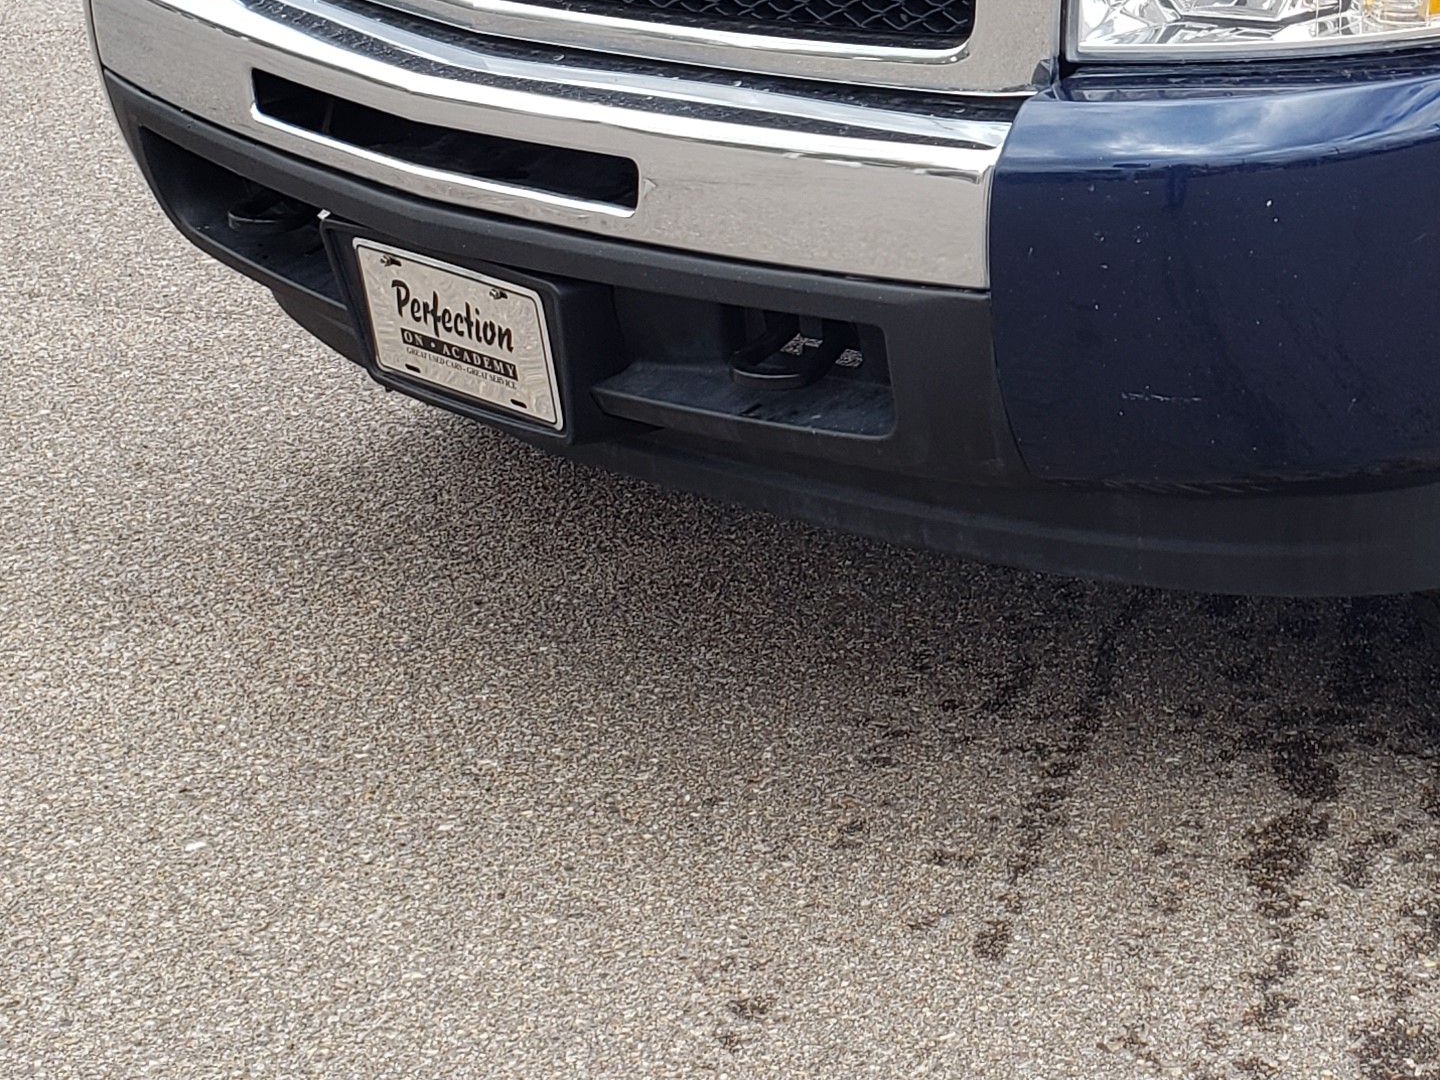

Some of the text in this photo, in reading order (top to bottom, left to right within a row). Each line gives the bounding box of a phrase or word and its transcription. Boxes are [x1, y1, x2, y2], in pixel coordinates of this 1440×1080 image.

[391, 279, 514, 353] Perfection
[403, 331, 516, 378] ON ACADEMY
